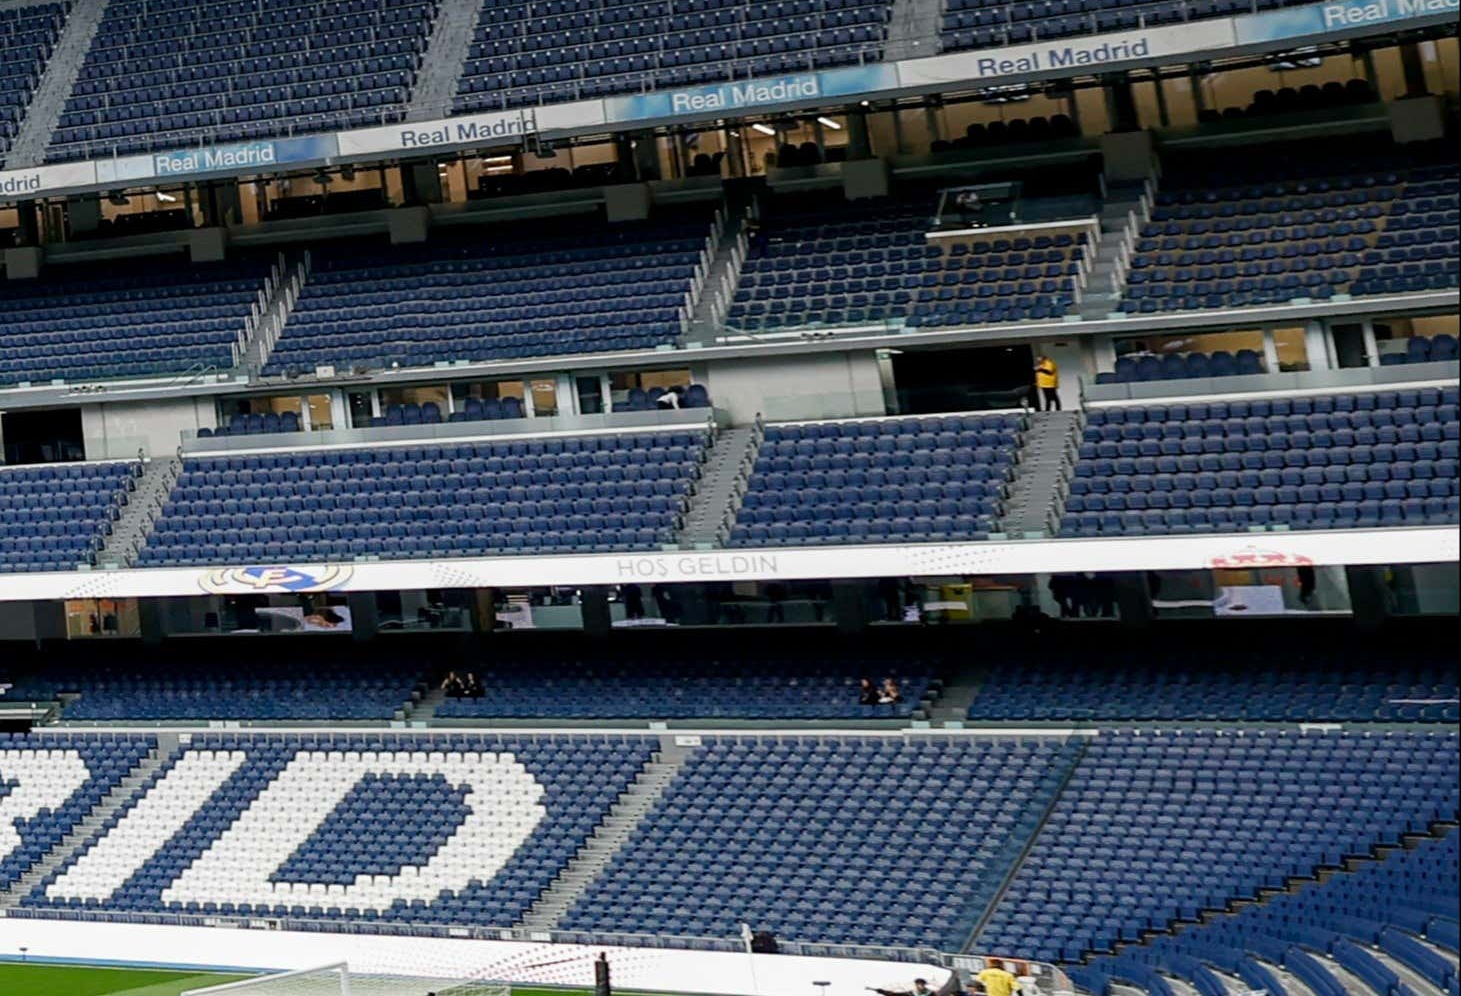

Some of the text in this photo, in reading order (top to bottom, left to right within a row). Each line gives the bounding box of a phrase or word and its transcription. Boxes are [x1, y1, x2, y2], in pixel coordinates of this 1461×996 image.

[1324, 1, 1388, 28] Real
[978, 39, 1148, 77] Real Madrid
[672, 77, 816, 111] Real Madrid
[400, 116, 536, 147] Real Madrid
[156, 146, 274, 174] Real Madrid
